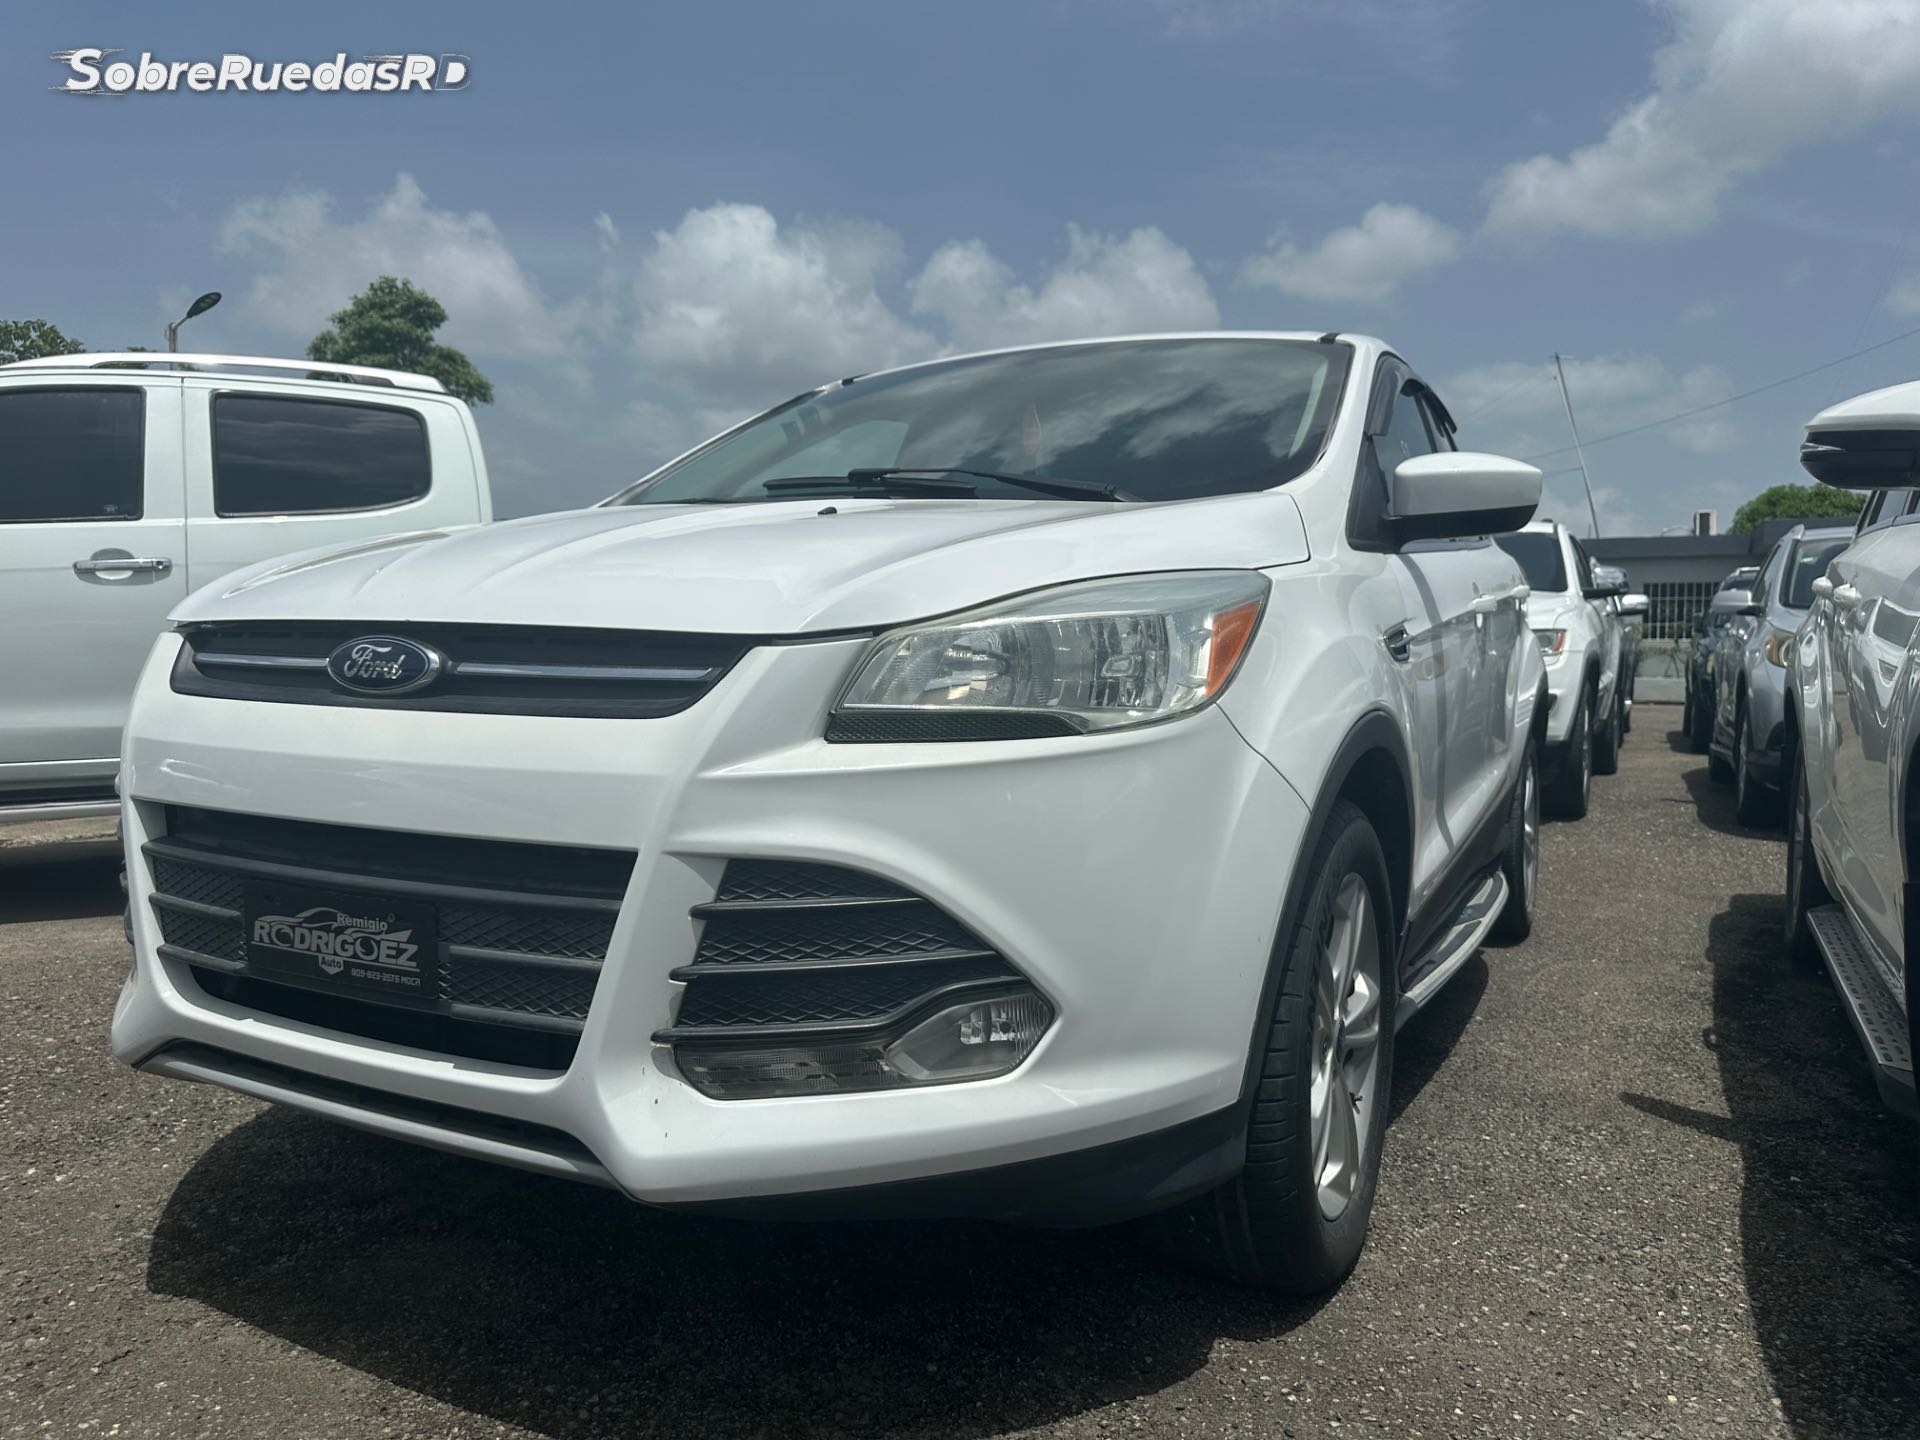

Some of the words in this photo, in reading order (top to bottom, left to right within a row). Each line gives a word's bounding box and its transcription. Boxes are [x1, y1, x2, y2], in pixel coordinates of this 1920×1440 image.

[344, 644, 406, 679] Ford
[336, 912, 388, 931] Remigio
[321, 957, 342, 969] Auto
